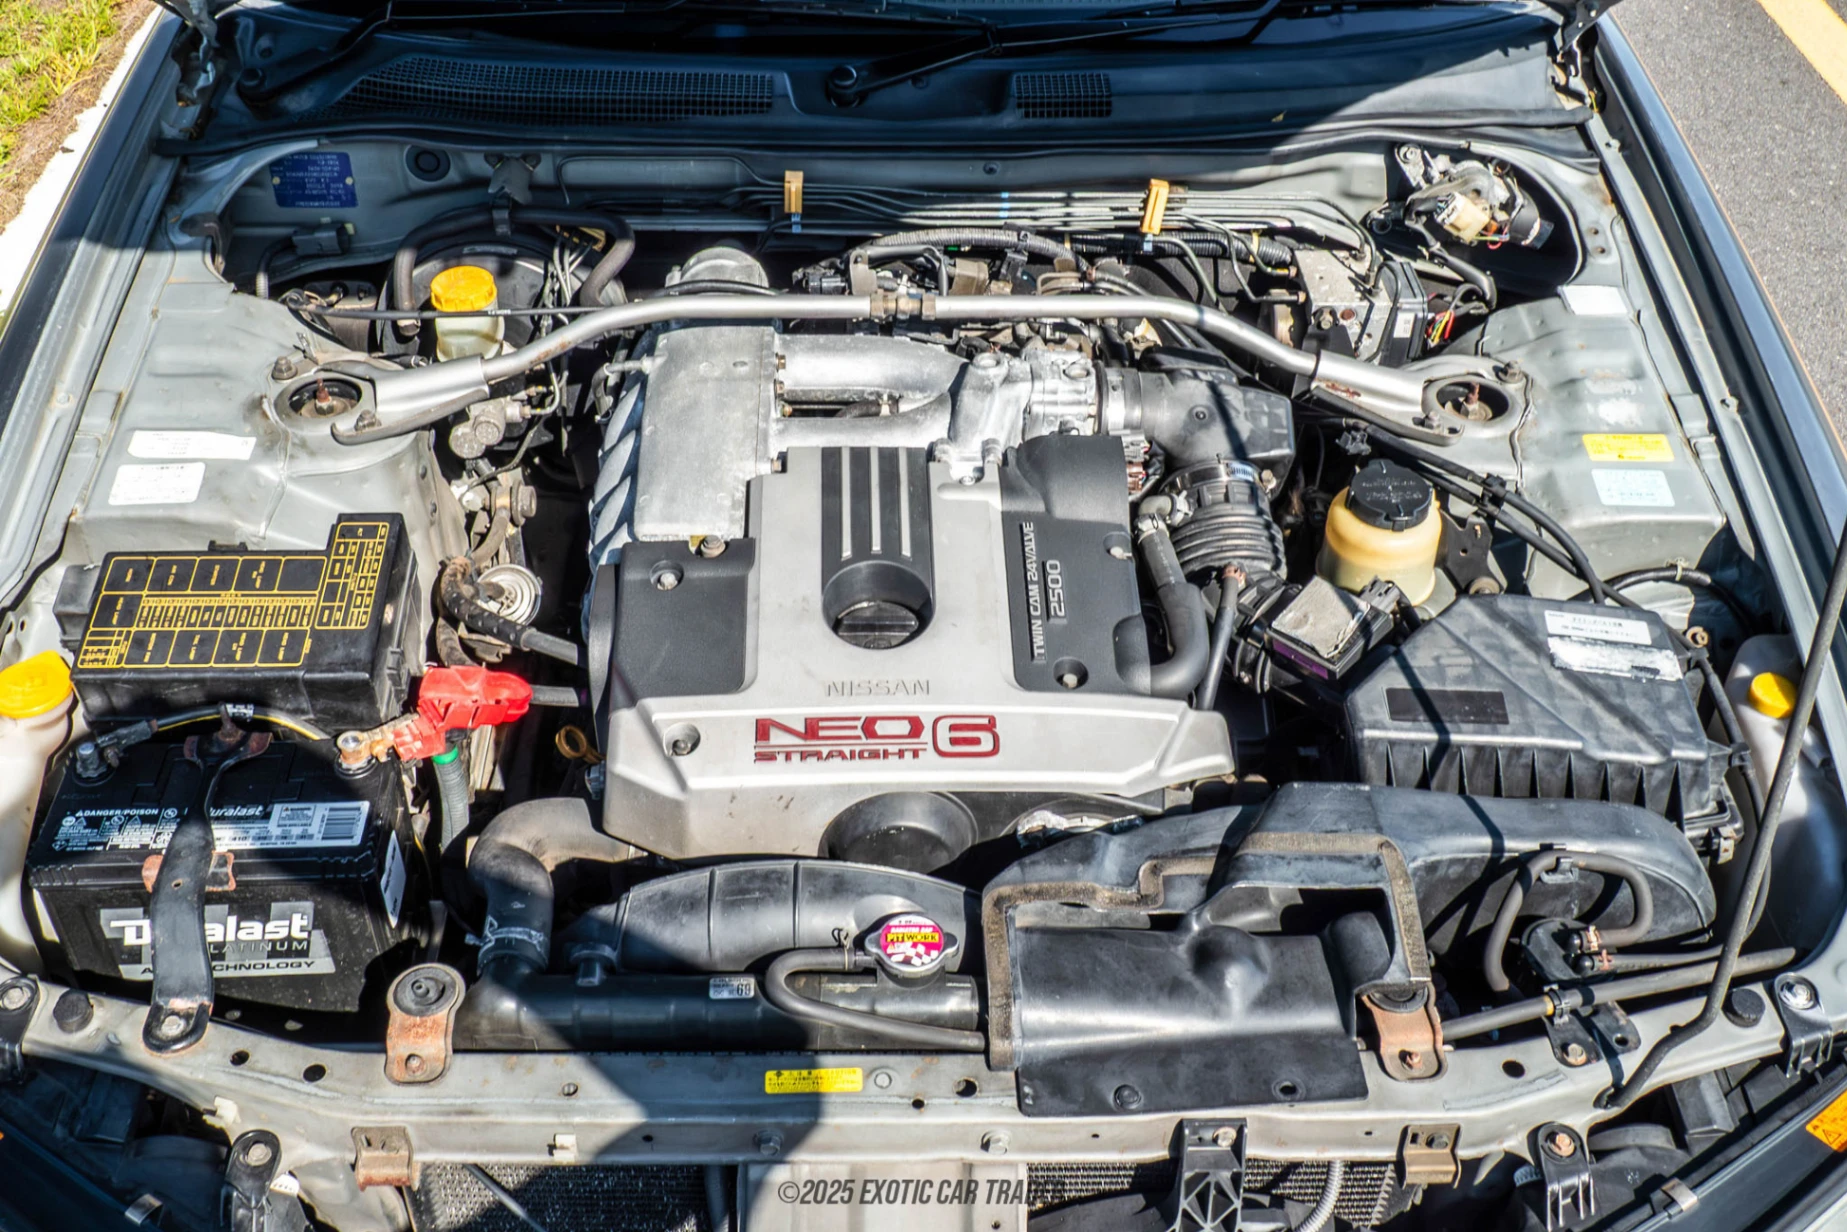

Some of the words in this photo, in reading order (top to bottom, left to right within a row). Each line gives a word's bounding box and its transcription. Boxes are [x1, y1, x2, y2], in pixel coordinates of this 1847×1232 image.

[1028, 584, 1041, 616] CAM
[1046, 559, 1065, 617] 2500
[1031, 619, 1045, 657] TWIN
[826, 679, 930, 697] NISSAN
[755, 714, 925, 743] NEO
[931, 714, 1000, 758] 6
[754, 748, 927, 763] STRAIGHT
[209, 805, 264, 817] uralast
[110, 912, 309, 946] Dalast
[210, 940, 308, 954] LATINUM
[212, 960, 316, 972] CHNOLOGY
